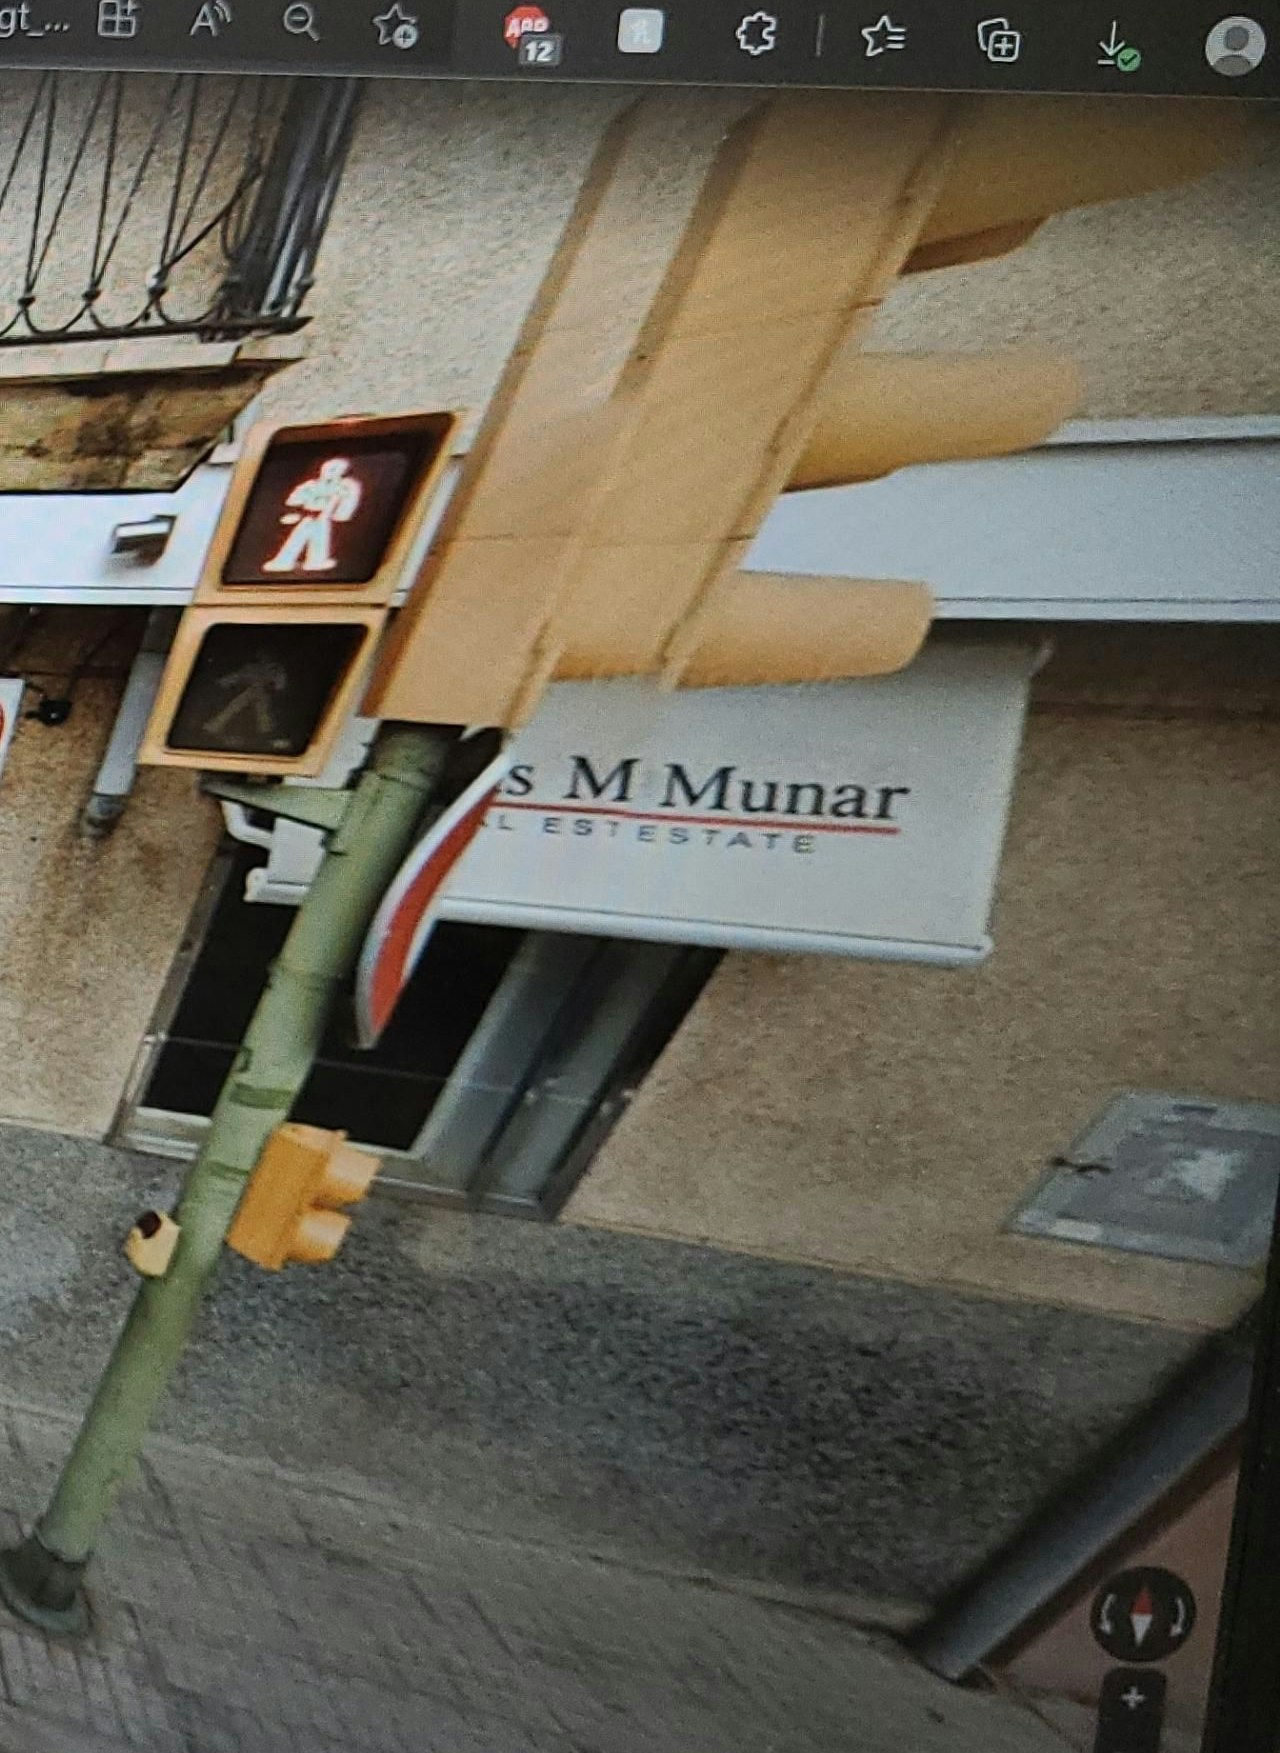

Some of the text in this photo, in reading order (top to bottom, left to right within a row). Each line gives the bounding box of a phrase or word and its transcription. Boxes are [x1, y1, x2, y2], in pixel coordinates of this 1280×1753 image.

[525, 40, 555, 62] 12
[561, 755, 642, 802] M
[658, 762, 912, 820] Munar
